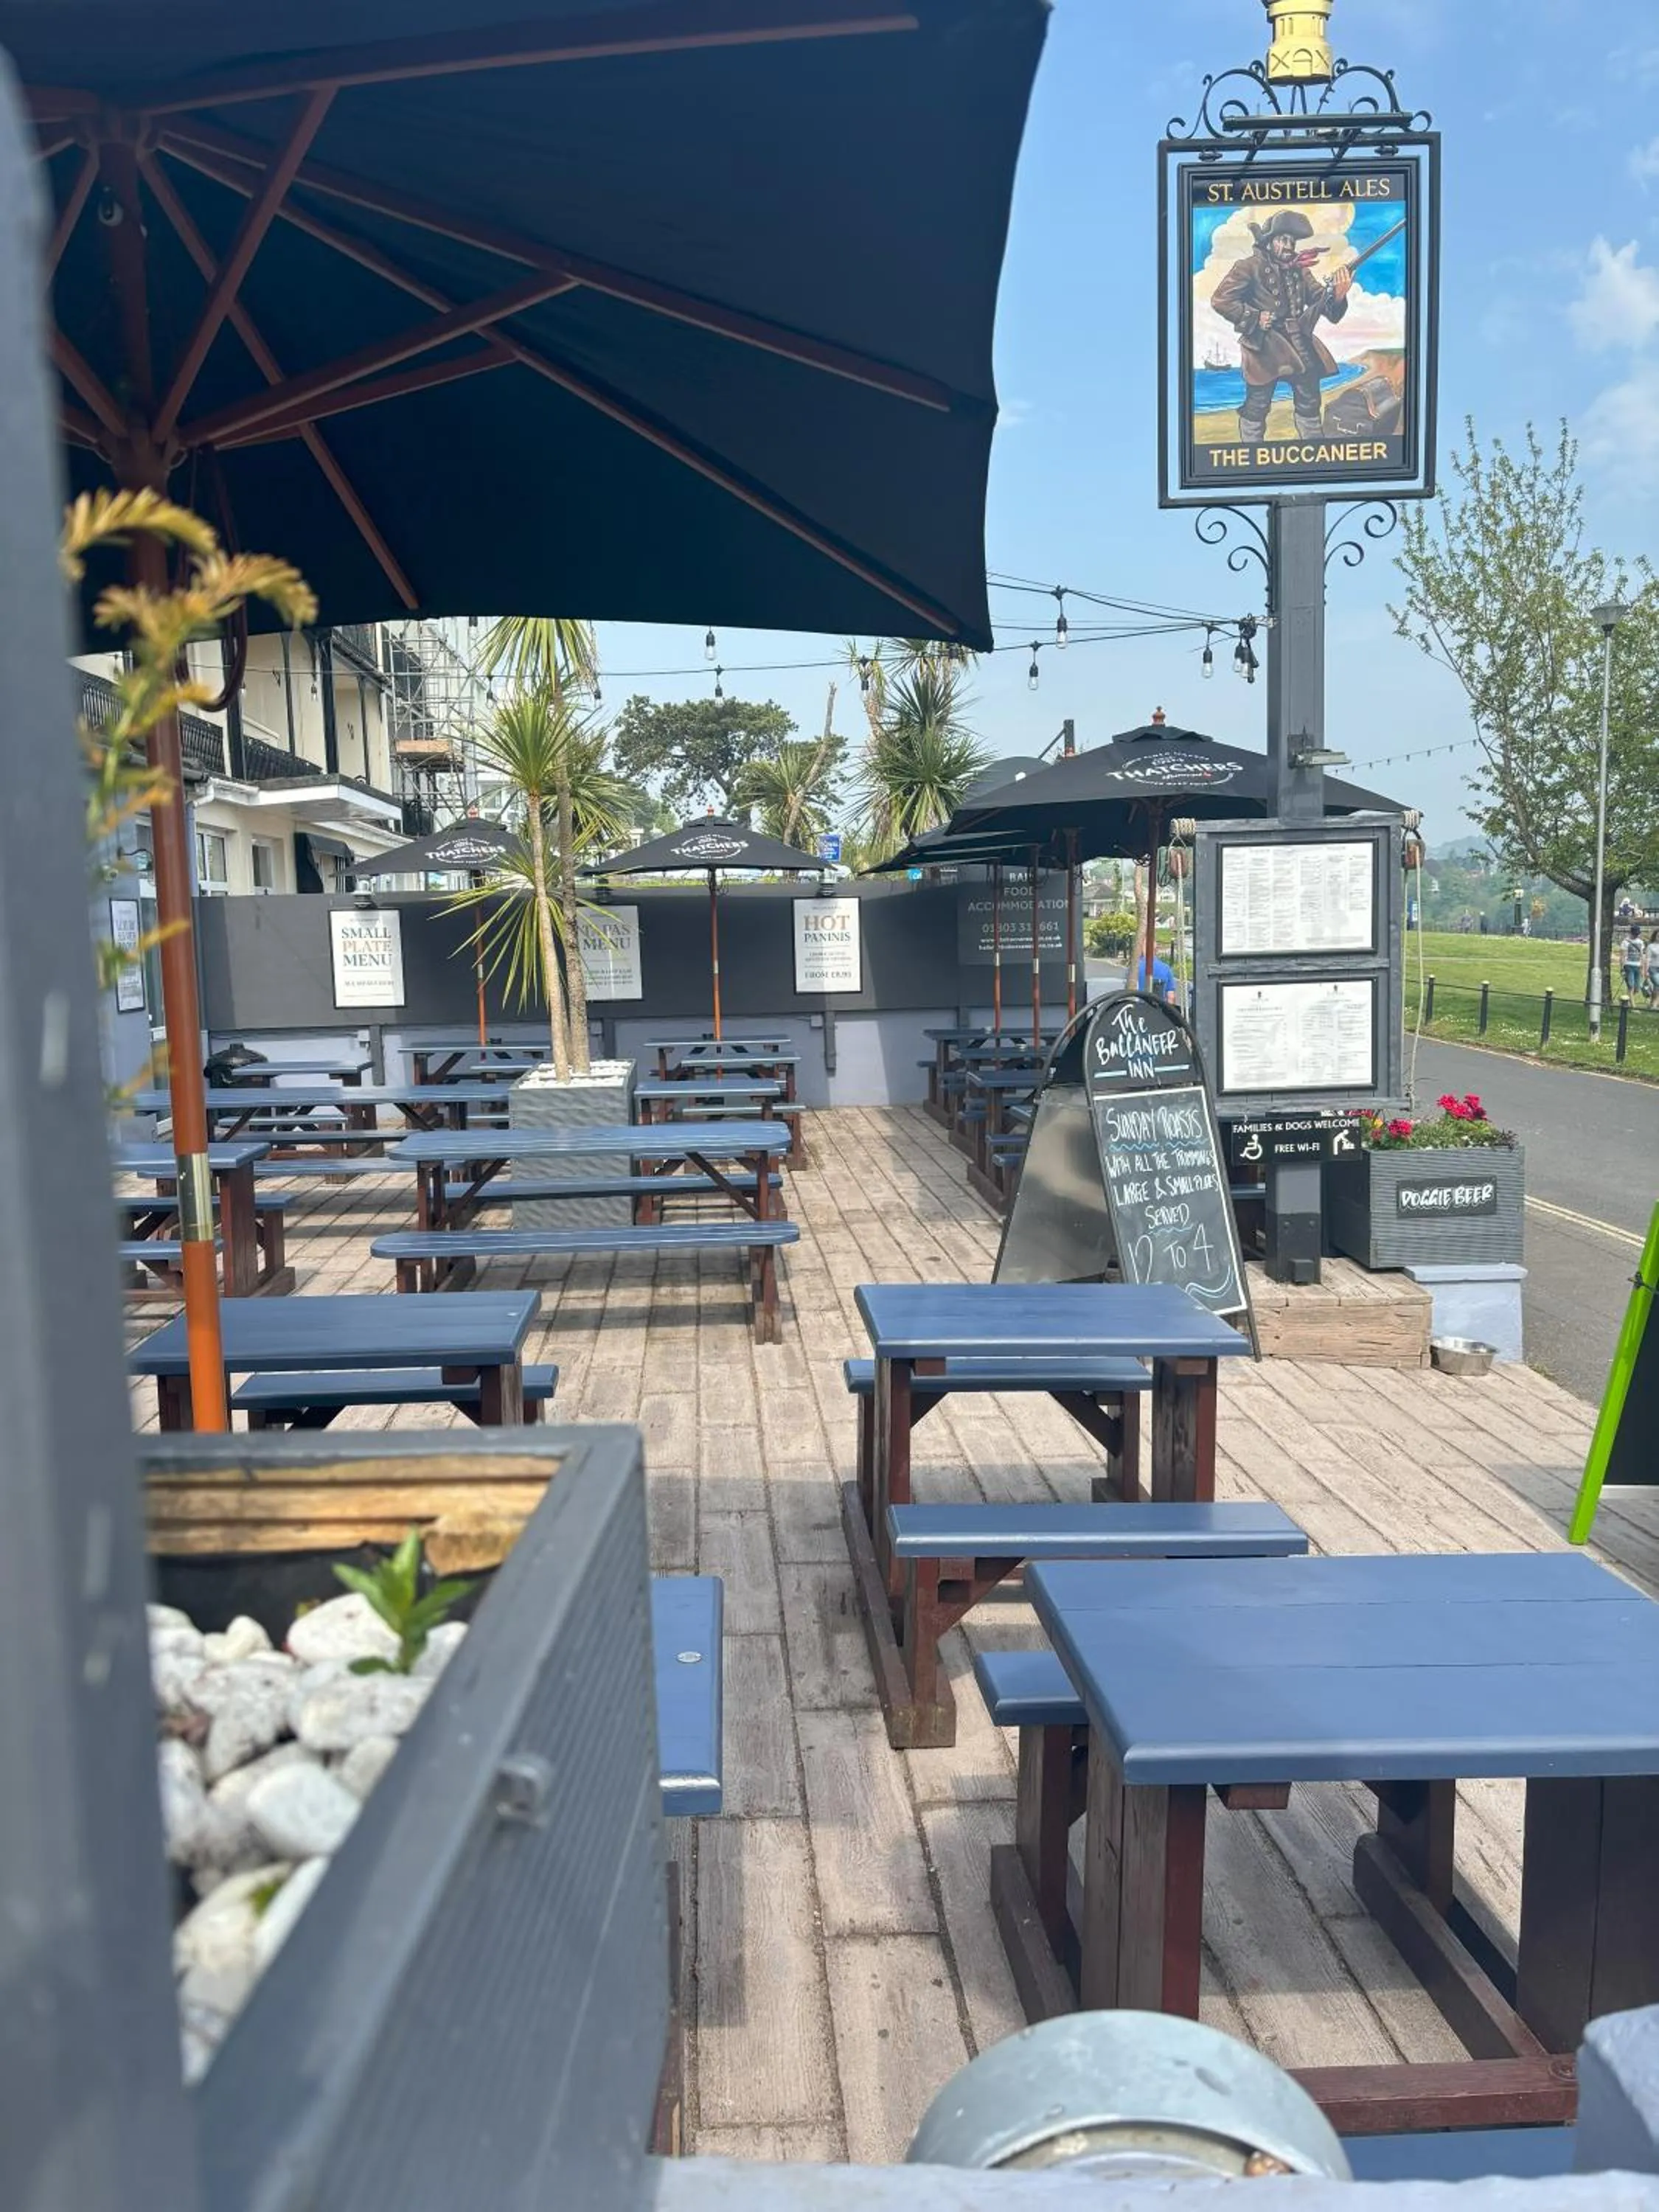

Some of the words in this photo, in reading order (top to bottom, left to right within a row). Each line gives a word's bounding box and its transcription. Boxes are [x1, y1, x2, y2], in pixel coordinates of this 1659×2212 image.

[1207, 183, 1234, 202] ST.
[1241, 180, 1332, 201] AUSTELL
[1339, 178, 1391, 198] ALES
[1209, 448, 1250, 467] THE
[1256, 442, 1388, 465] BUCCANEER
[1107, 762, 1244, 780] THATCHERS
[670, 841, 749, 855] THATCHERS
[341, 927, 392, 939] SMALL
[804, 915, 850, 931] HOT
[343, 940, 393, 953] PLATE
[804, 932, 851, 942] PANINIS
[343, 954, 392, 967] MENU
[1111, 1004, 1148, 1035] The
[1127, 1057, 1155, 1079] INN
[1106, 1107, 1157, 1143] SUNDAY
[1158, 1106, 1203, 1140] ROASTS
[1233, 1124, 1272, 1133] FAMILIES
[1275, 1123, 1284, 1132] &
[1285, 1121, 1312, 1130] DOGS
[1314, 1118, 1360, 1128] WELCOME
[1274, 1144, 1295, 1153] FREE
[1105, 1154, 1132, 1179] WITH
[1135, 1152, 1153, 1172] ALL
[1152, 1152, 1171, 1169] THE
[1113, 1180, 1150, 1206] LARGE
[1402, 1189, 1451, 1207] DOGGIE
[1455, 1184, 1493, 1204] BEER
[1145, 1203, 1189, 1229] SERVED
[1193, 1222, 1214, 1272] 4
